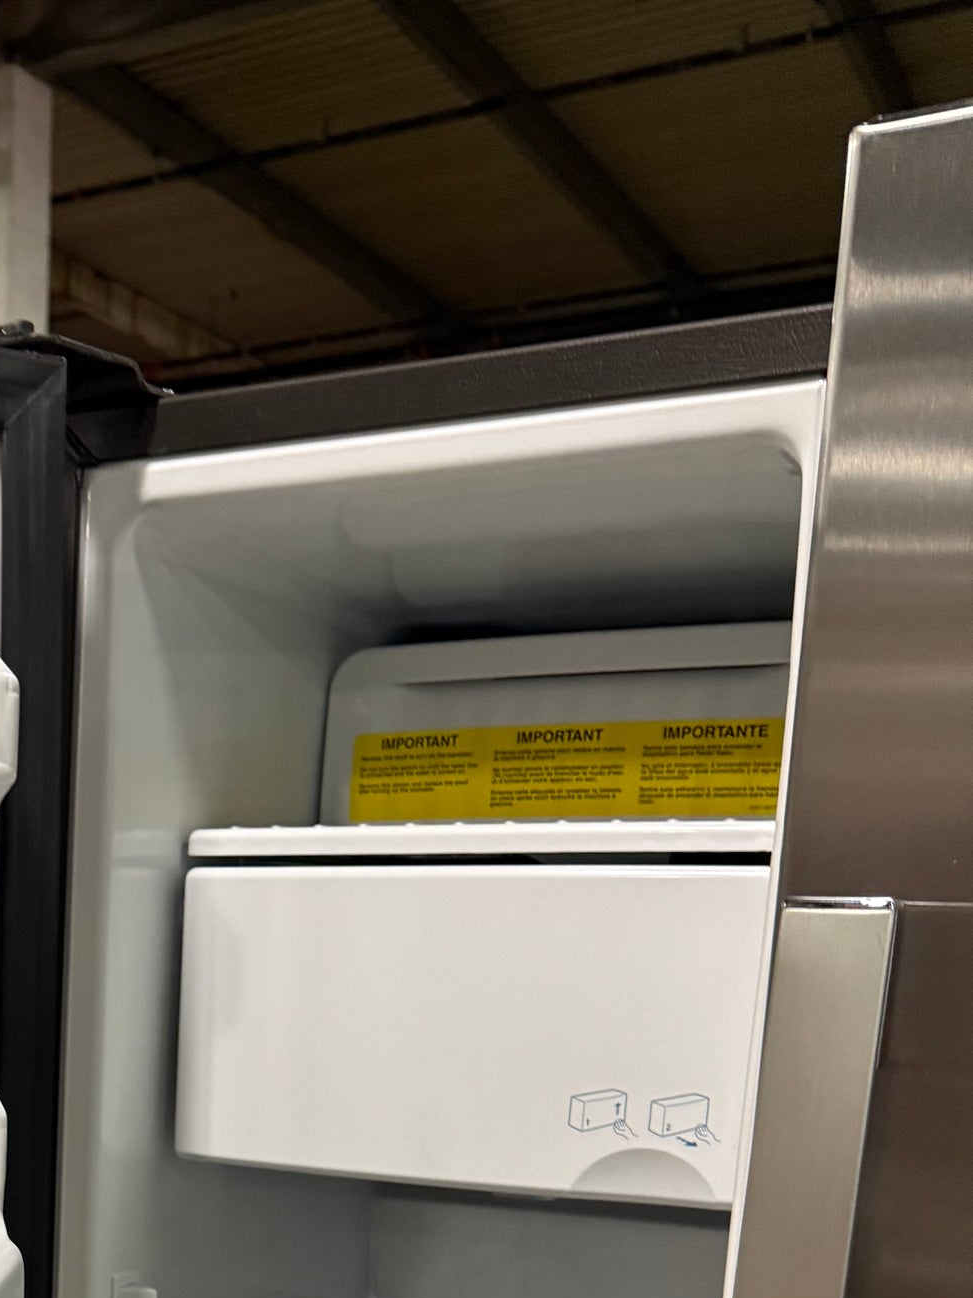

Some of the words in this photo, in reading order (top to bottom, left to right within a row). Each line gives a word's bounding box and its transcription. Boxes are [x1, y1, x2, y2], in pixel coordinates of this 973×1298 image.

[517, 728, 604, 744] IMPORTANT
[663, 724, 769, 739] IMPORTANTE
[381, 735, 458, 750] IMPORTANT
